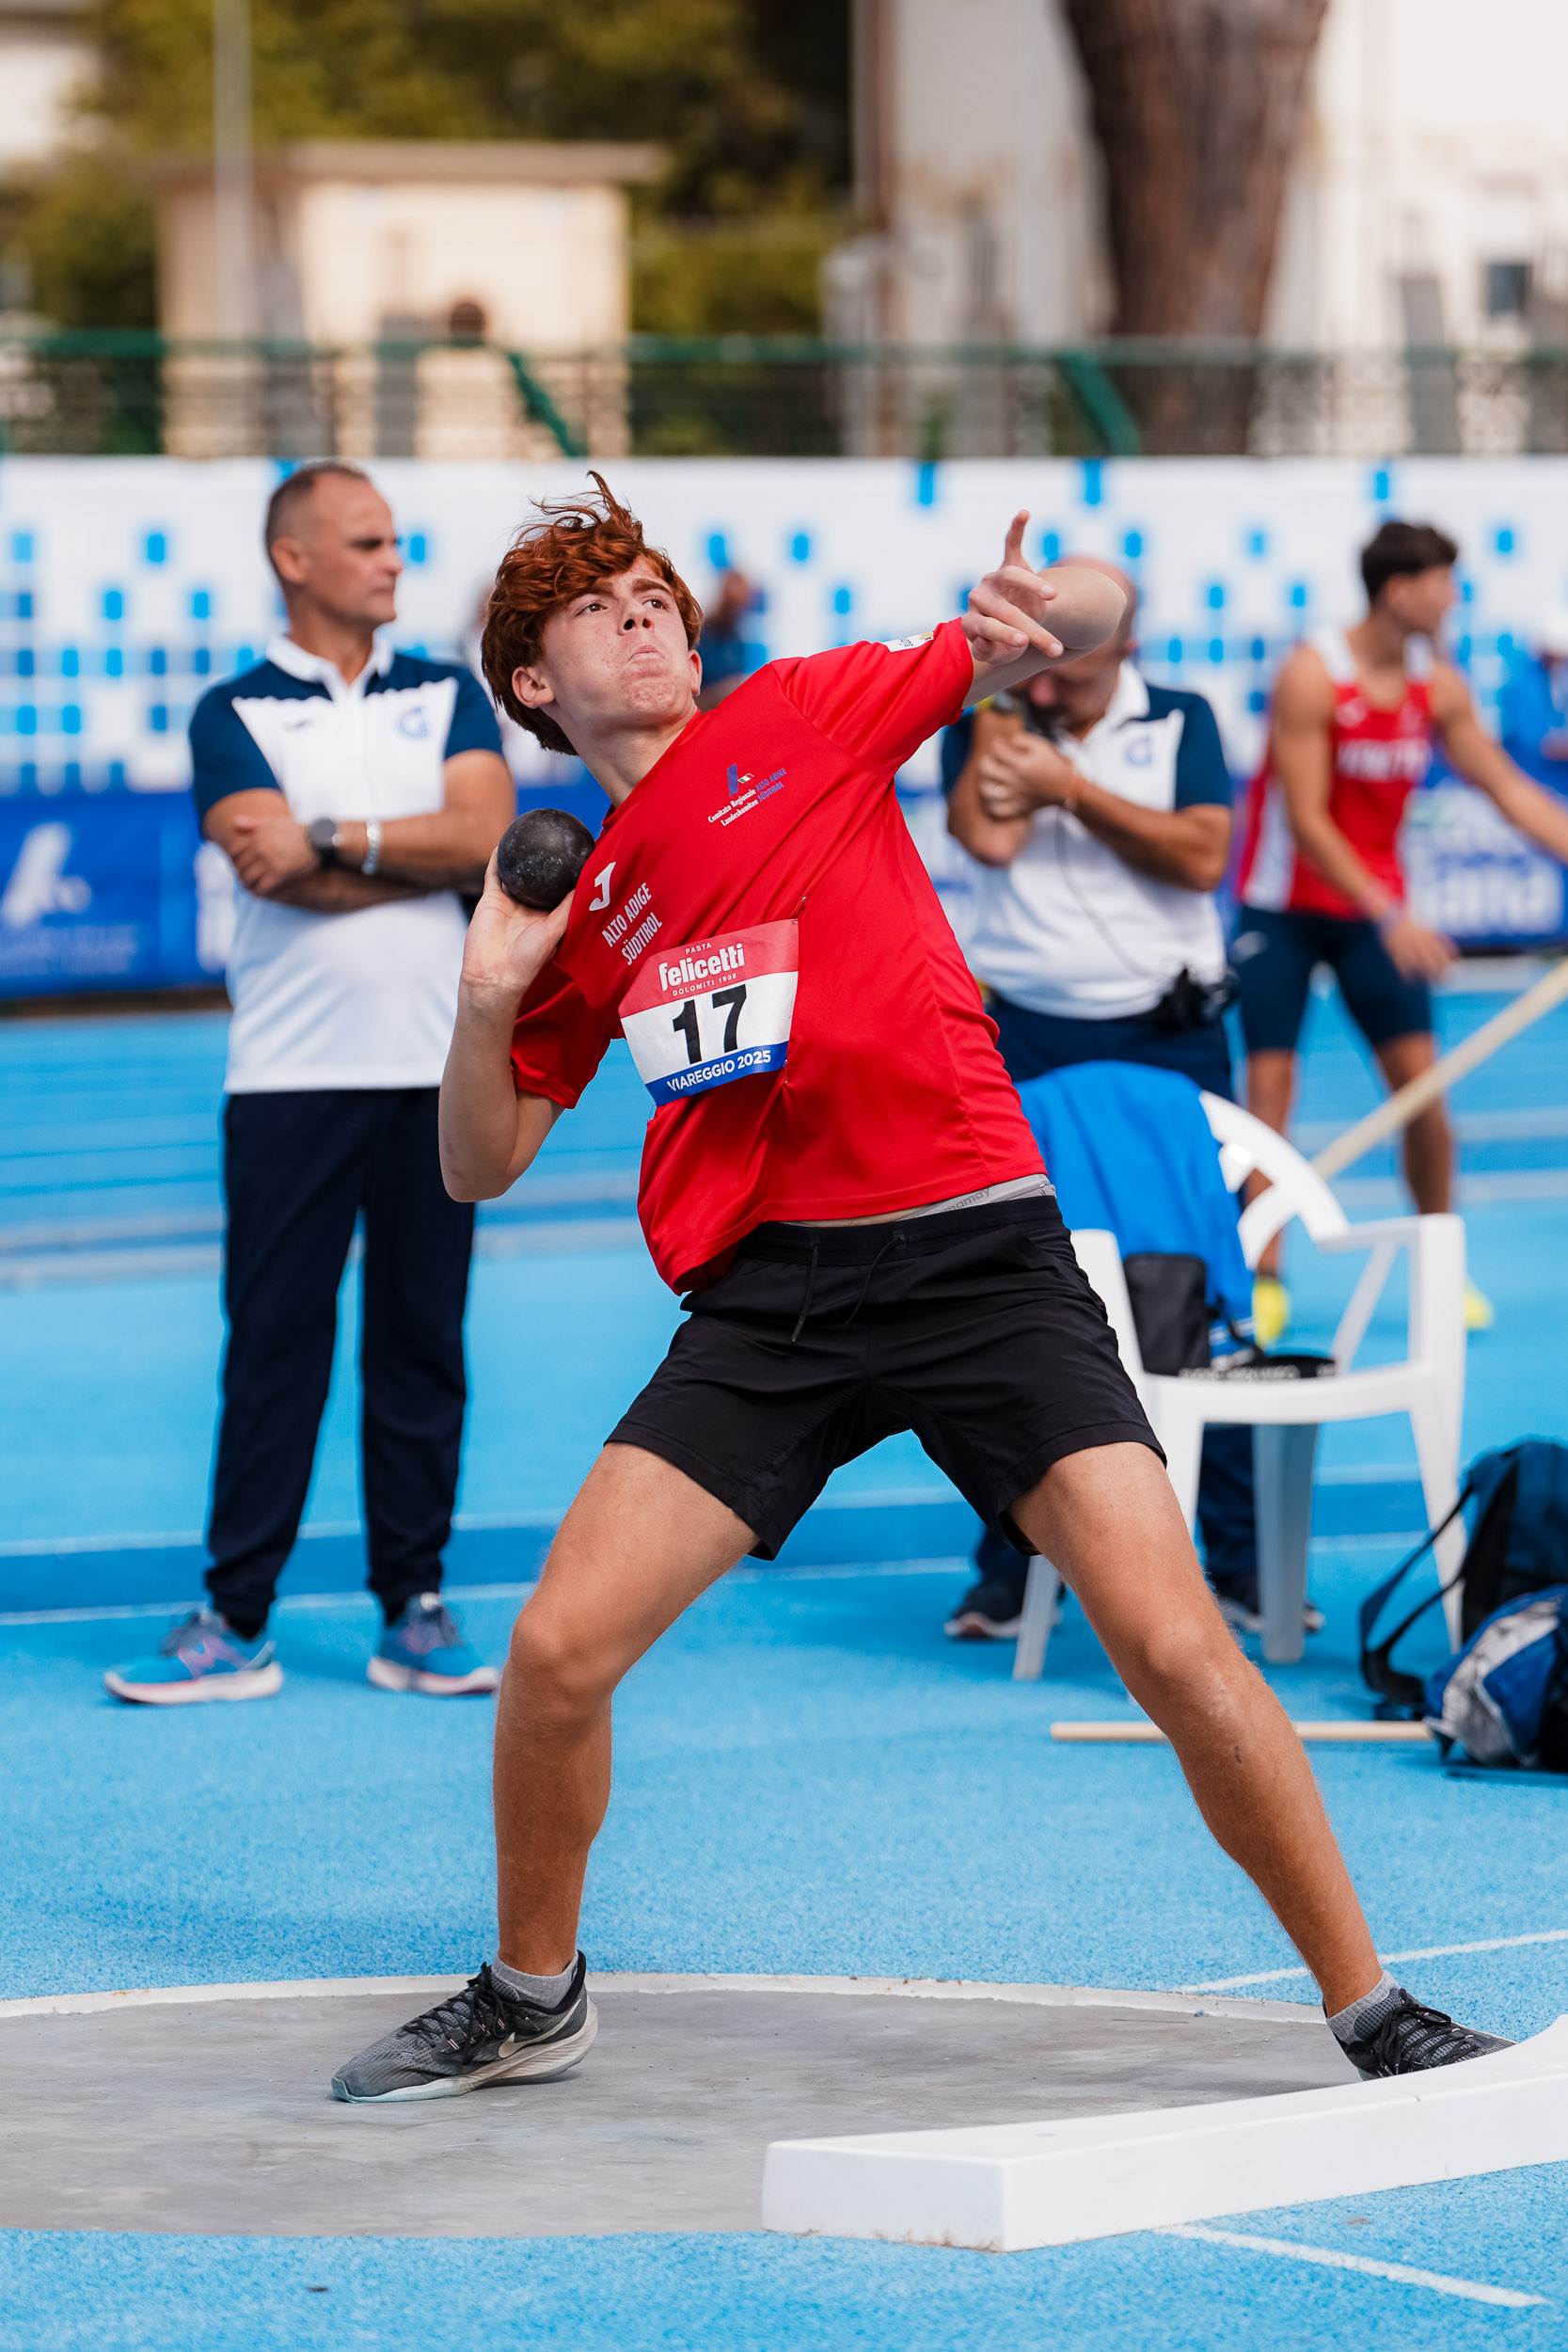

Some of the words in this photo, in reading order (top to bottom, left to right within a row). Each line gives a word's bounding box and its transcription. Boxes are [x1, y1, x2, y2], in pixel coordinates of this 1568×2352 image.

[707, 804, 732, 823] Comitato
[730, 788, 756, 808] Regionale
[755, 778, 769, 791] ALTO
[769, 767, 786, 783] ADIGE
[721, 799, 759, 827] Landeskomitee
[757, 781, 784, 802] SÜDTIROL
[601, 914, 627, 948] ALTO
[624, 882, 653, 924] ADIGE
[621, 912, 663, 966] SÜDTIROL
[658, 943, 746, 992] felicetti
[685, 942, 712, 955] PASTA
[672, 979, 715, 996] DOLOMITI
[718, 973, 737, 984] 1908
[672, 983, 747, 1065] 17
[666, 1059, 736, 1092] VIAREGGIO
[736, 1049, 771, 1070] 2025
